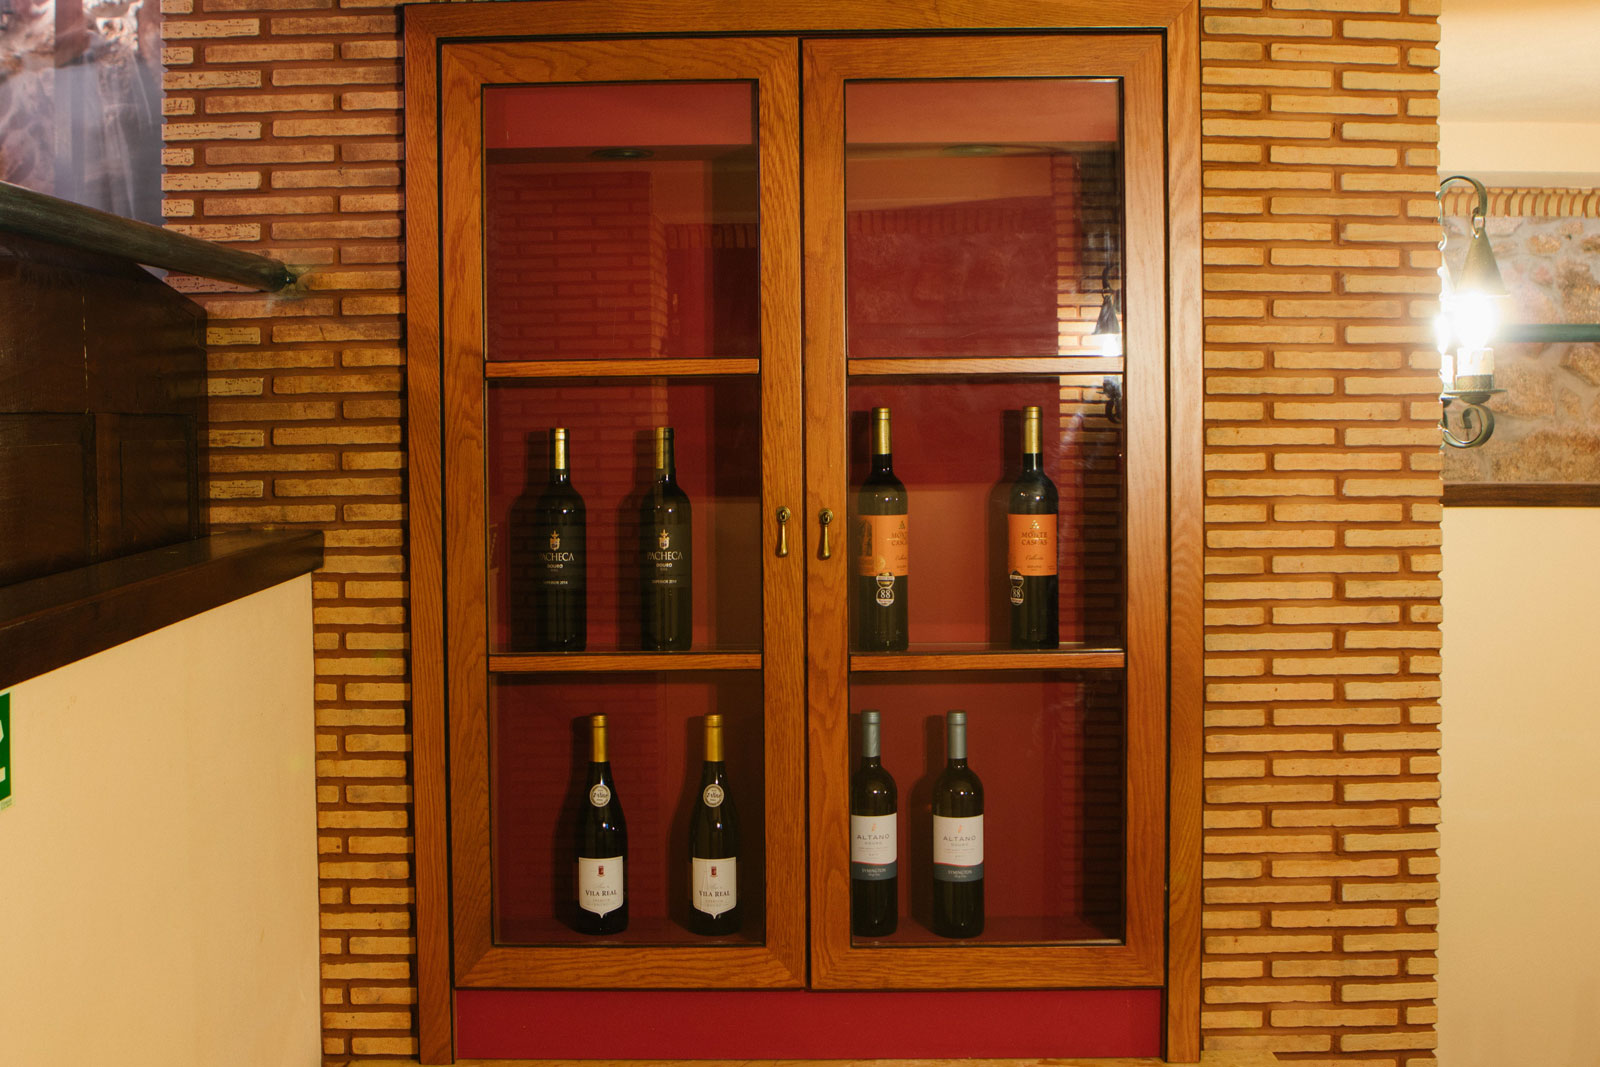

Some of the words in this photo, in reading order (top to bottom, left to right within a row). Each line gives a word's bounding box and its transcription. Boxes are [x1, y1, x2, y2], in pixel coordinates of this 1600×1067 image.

[647, 551, 683, 561] PACHECA
[880, 589, 891, 599] 88
[1012, 588, 1021, 598] 88
[856, 833, 890, 841] ALTANO
[585, 889, 600, 897] VILA
[601, 889, 617, 897] REAL
[714, 890, 730, 898] REAL
